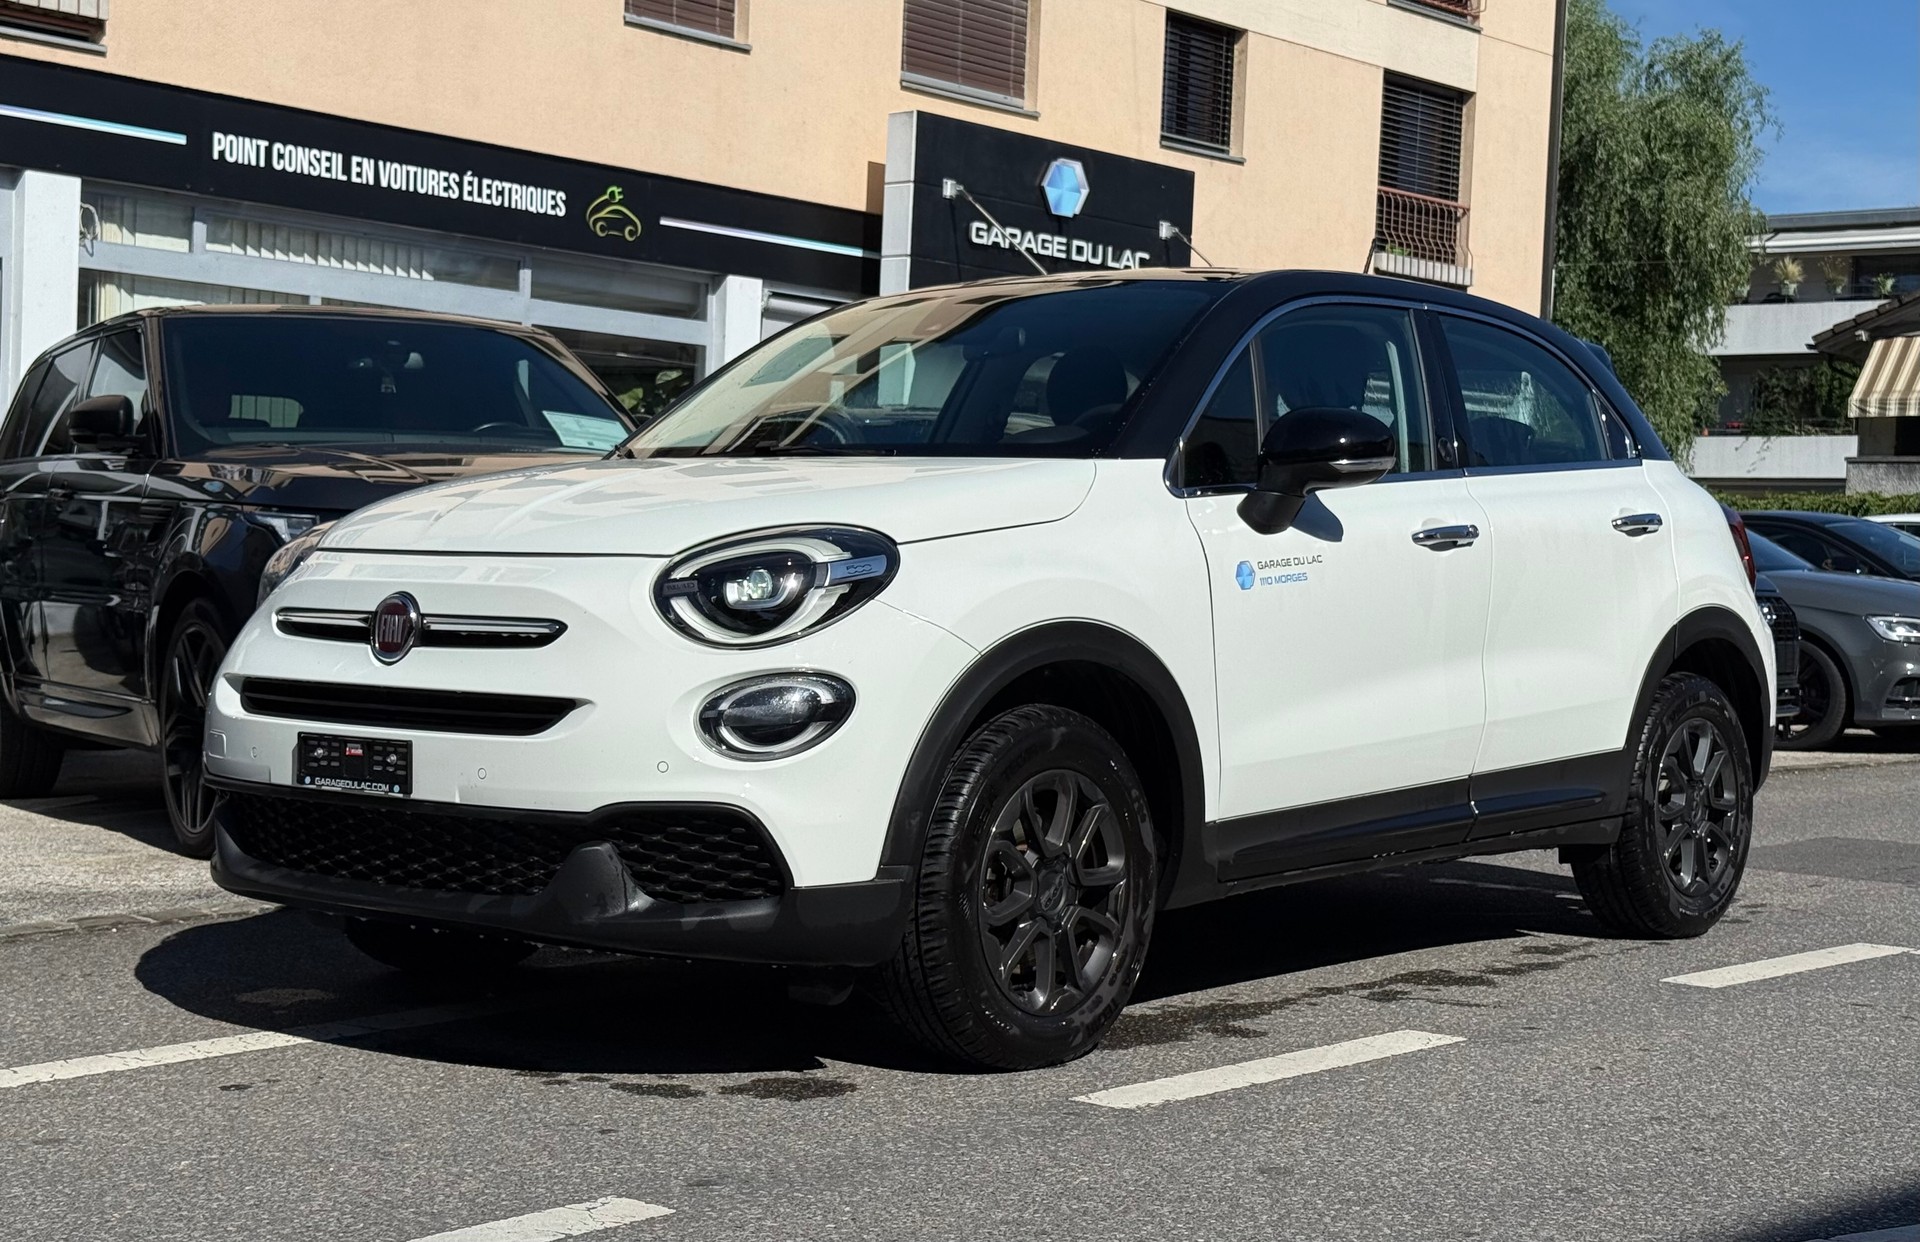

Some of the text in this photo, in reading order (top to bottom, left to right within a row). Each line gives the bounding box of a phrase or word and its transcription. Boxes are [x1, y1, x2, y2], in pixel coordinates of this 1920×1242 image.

[212, 131, 567, 217] POINT CONSEIL EN VOITURES ÉLECTRIQUES
[969, 221, 1150, 270] GARAGE DU LAC
[1257, 554, 1323, 570] GARAGE DU LAC
[1259, 572, 1308, 586] 1110 MORGES
[379, 614, 406, 643] FIAT
[315, 777, 389, 792] GARAGEDULAC.COM
